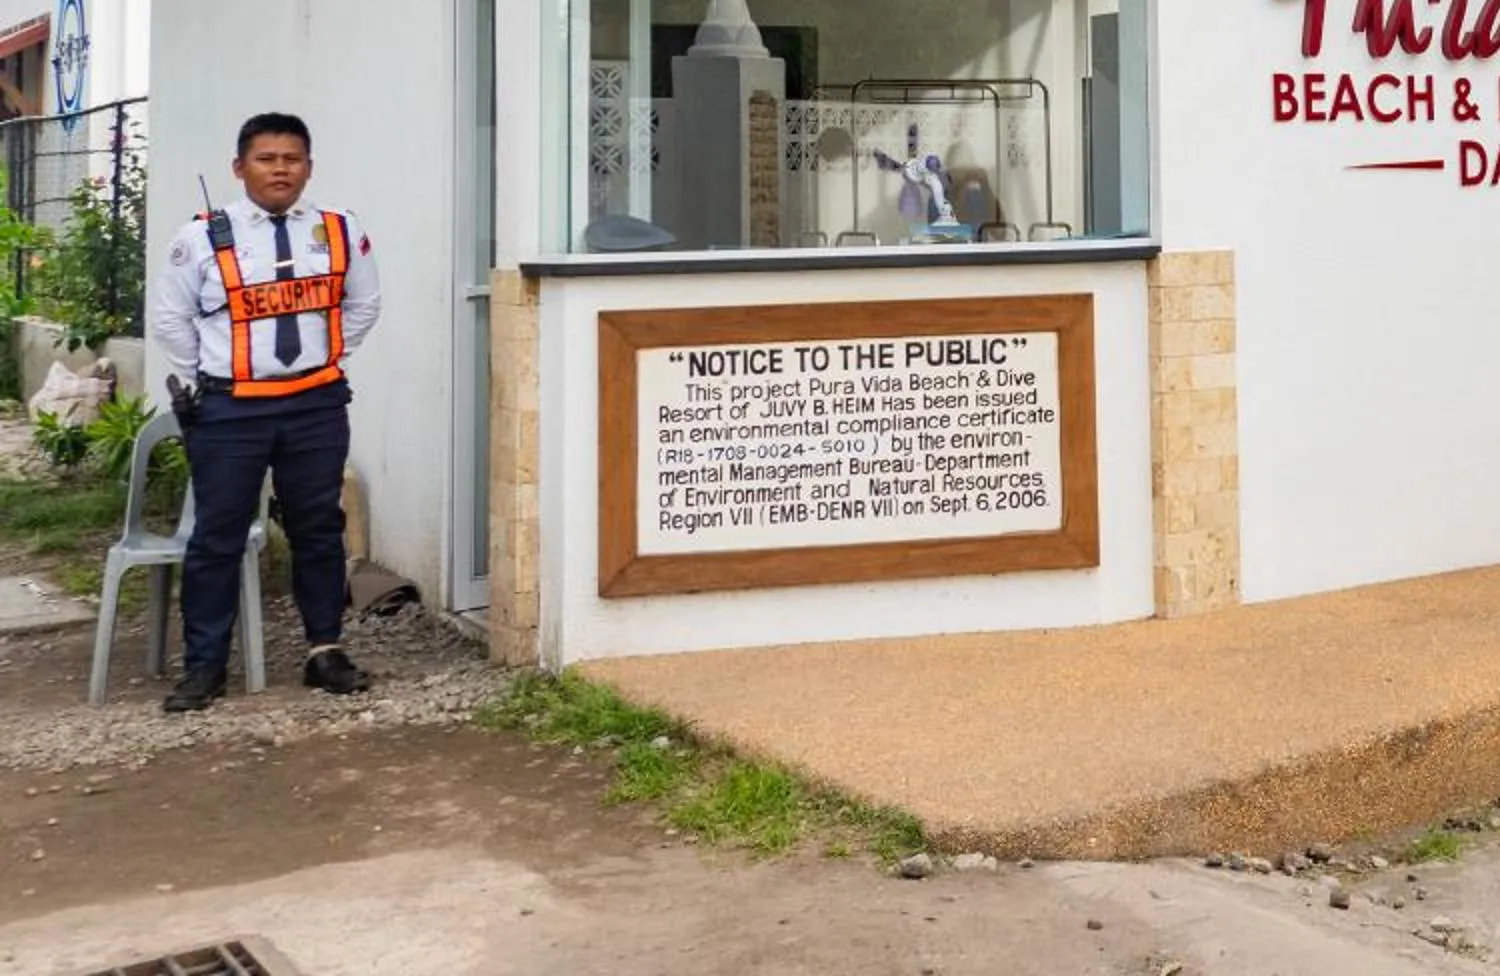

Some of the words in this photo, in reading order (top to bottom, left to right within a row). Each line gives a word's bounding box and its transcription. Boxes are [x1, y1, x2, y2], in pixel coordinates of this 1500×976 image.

[1272, 73, 1435, 122] BEACH
[1452, 77, 1480, 120] &
[241, 278, 336, 316] SECURITY
[794, 346, 830, 372] TO
[838, 342, 895, 370] THE
[685, 384, 723, 402] This
[730, 379, 801, 403] project
[809, 377, 856, 397] Pura
[861, 373, 903, 393] Vida
[909, 369, 970, 391] Beach
[976, 370, 991, 387] &
[997, 369, 1036, 387] Dive
[659, 403, 724, 424] Resort
[729, 401, 751, 420] of
[759, 398, 808, 418] JUVY
[813, 398, 829, 417] B.
[833, 395, 876, 416] HEIM
[923, 392, 970, 410] been
[975, 388, 1038, 408] issued
[659, 427, 685, 444] an
[690, 419, 829, 442] environmental
[837, 412, 951, 436] compliance
[957, 405, 1055, 427] certificate
[891, 434, 914, 457] by
[918, 432, 946, 450] the
[951, 427, 1034, 449] environ-
[659, 464, 723, 486] mental
[729, 460, 843, 483] Management
[659, 488, 678, 508] of
[685, 481, 802, 507] Environment
[810, 479, 852, 499] and
[869, 474, 936, 497] Natural
[659, 509, 724, 534] Region
[729, 506, 754, 526] VII
[871, 497, 900, 518] VII)
[902, 500, 925, 515] on
